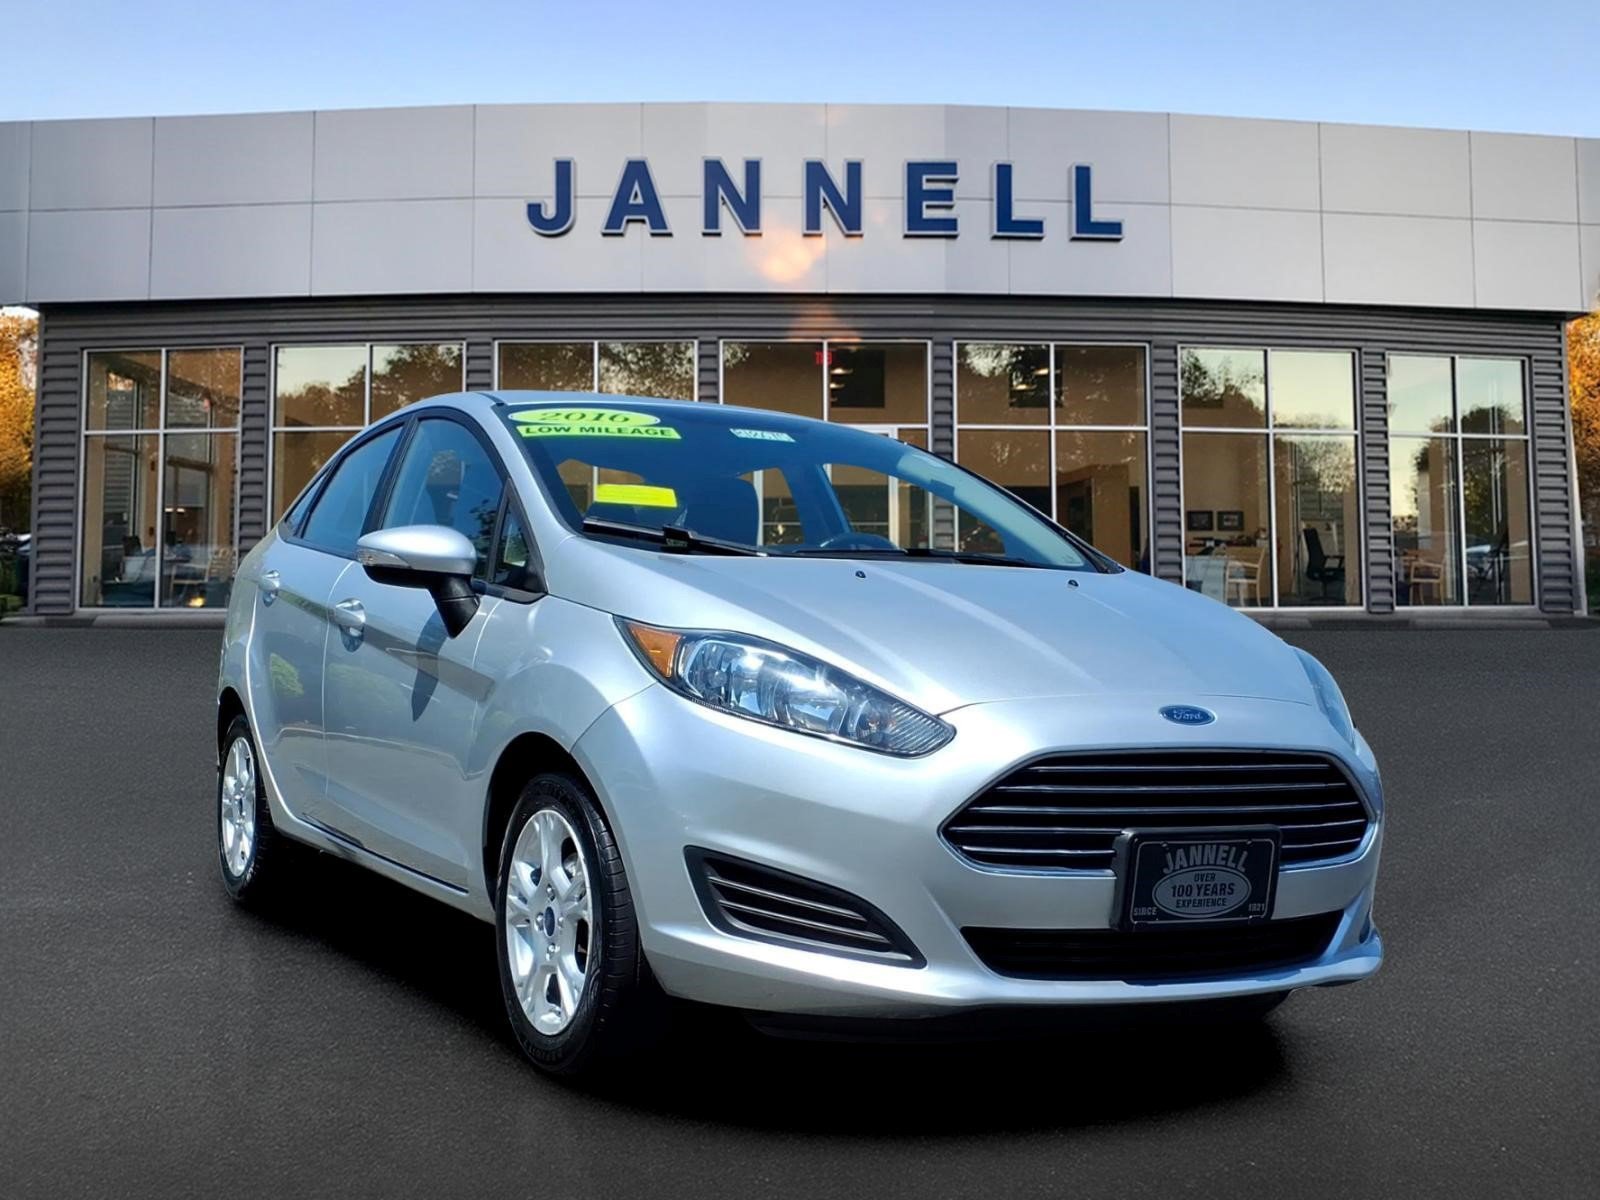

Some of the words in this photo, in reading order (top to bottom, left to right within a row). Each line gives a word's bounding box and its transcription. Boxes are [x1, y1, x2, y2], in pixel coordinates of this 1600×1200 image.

[526, 157, 1123, 241] JANNELL
[539, 412, 630, 423] 2016
[525, 426, 571, 434] LOW
[579, 426, 672, 436] MILEAGE
[1172, 709, 1203, 720] Ford
[1163, 844, 1248, 874] JANNELL
[1194, 872, 1217, 882] OVER
[1171, 885, 1193, 898] 100
[1196, 883, 1235, 897] YEARS
[1175, 897, 1227, 909] EXPERIENCE
[1133, 906, 1158, 916] SINCE
